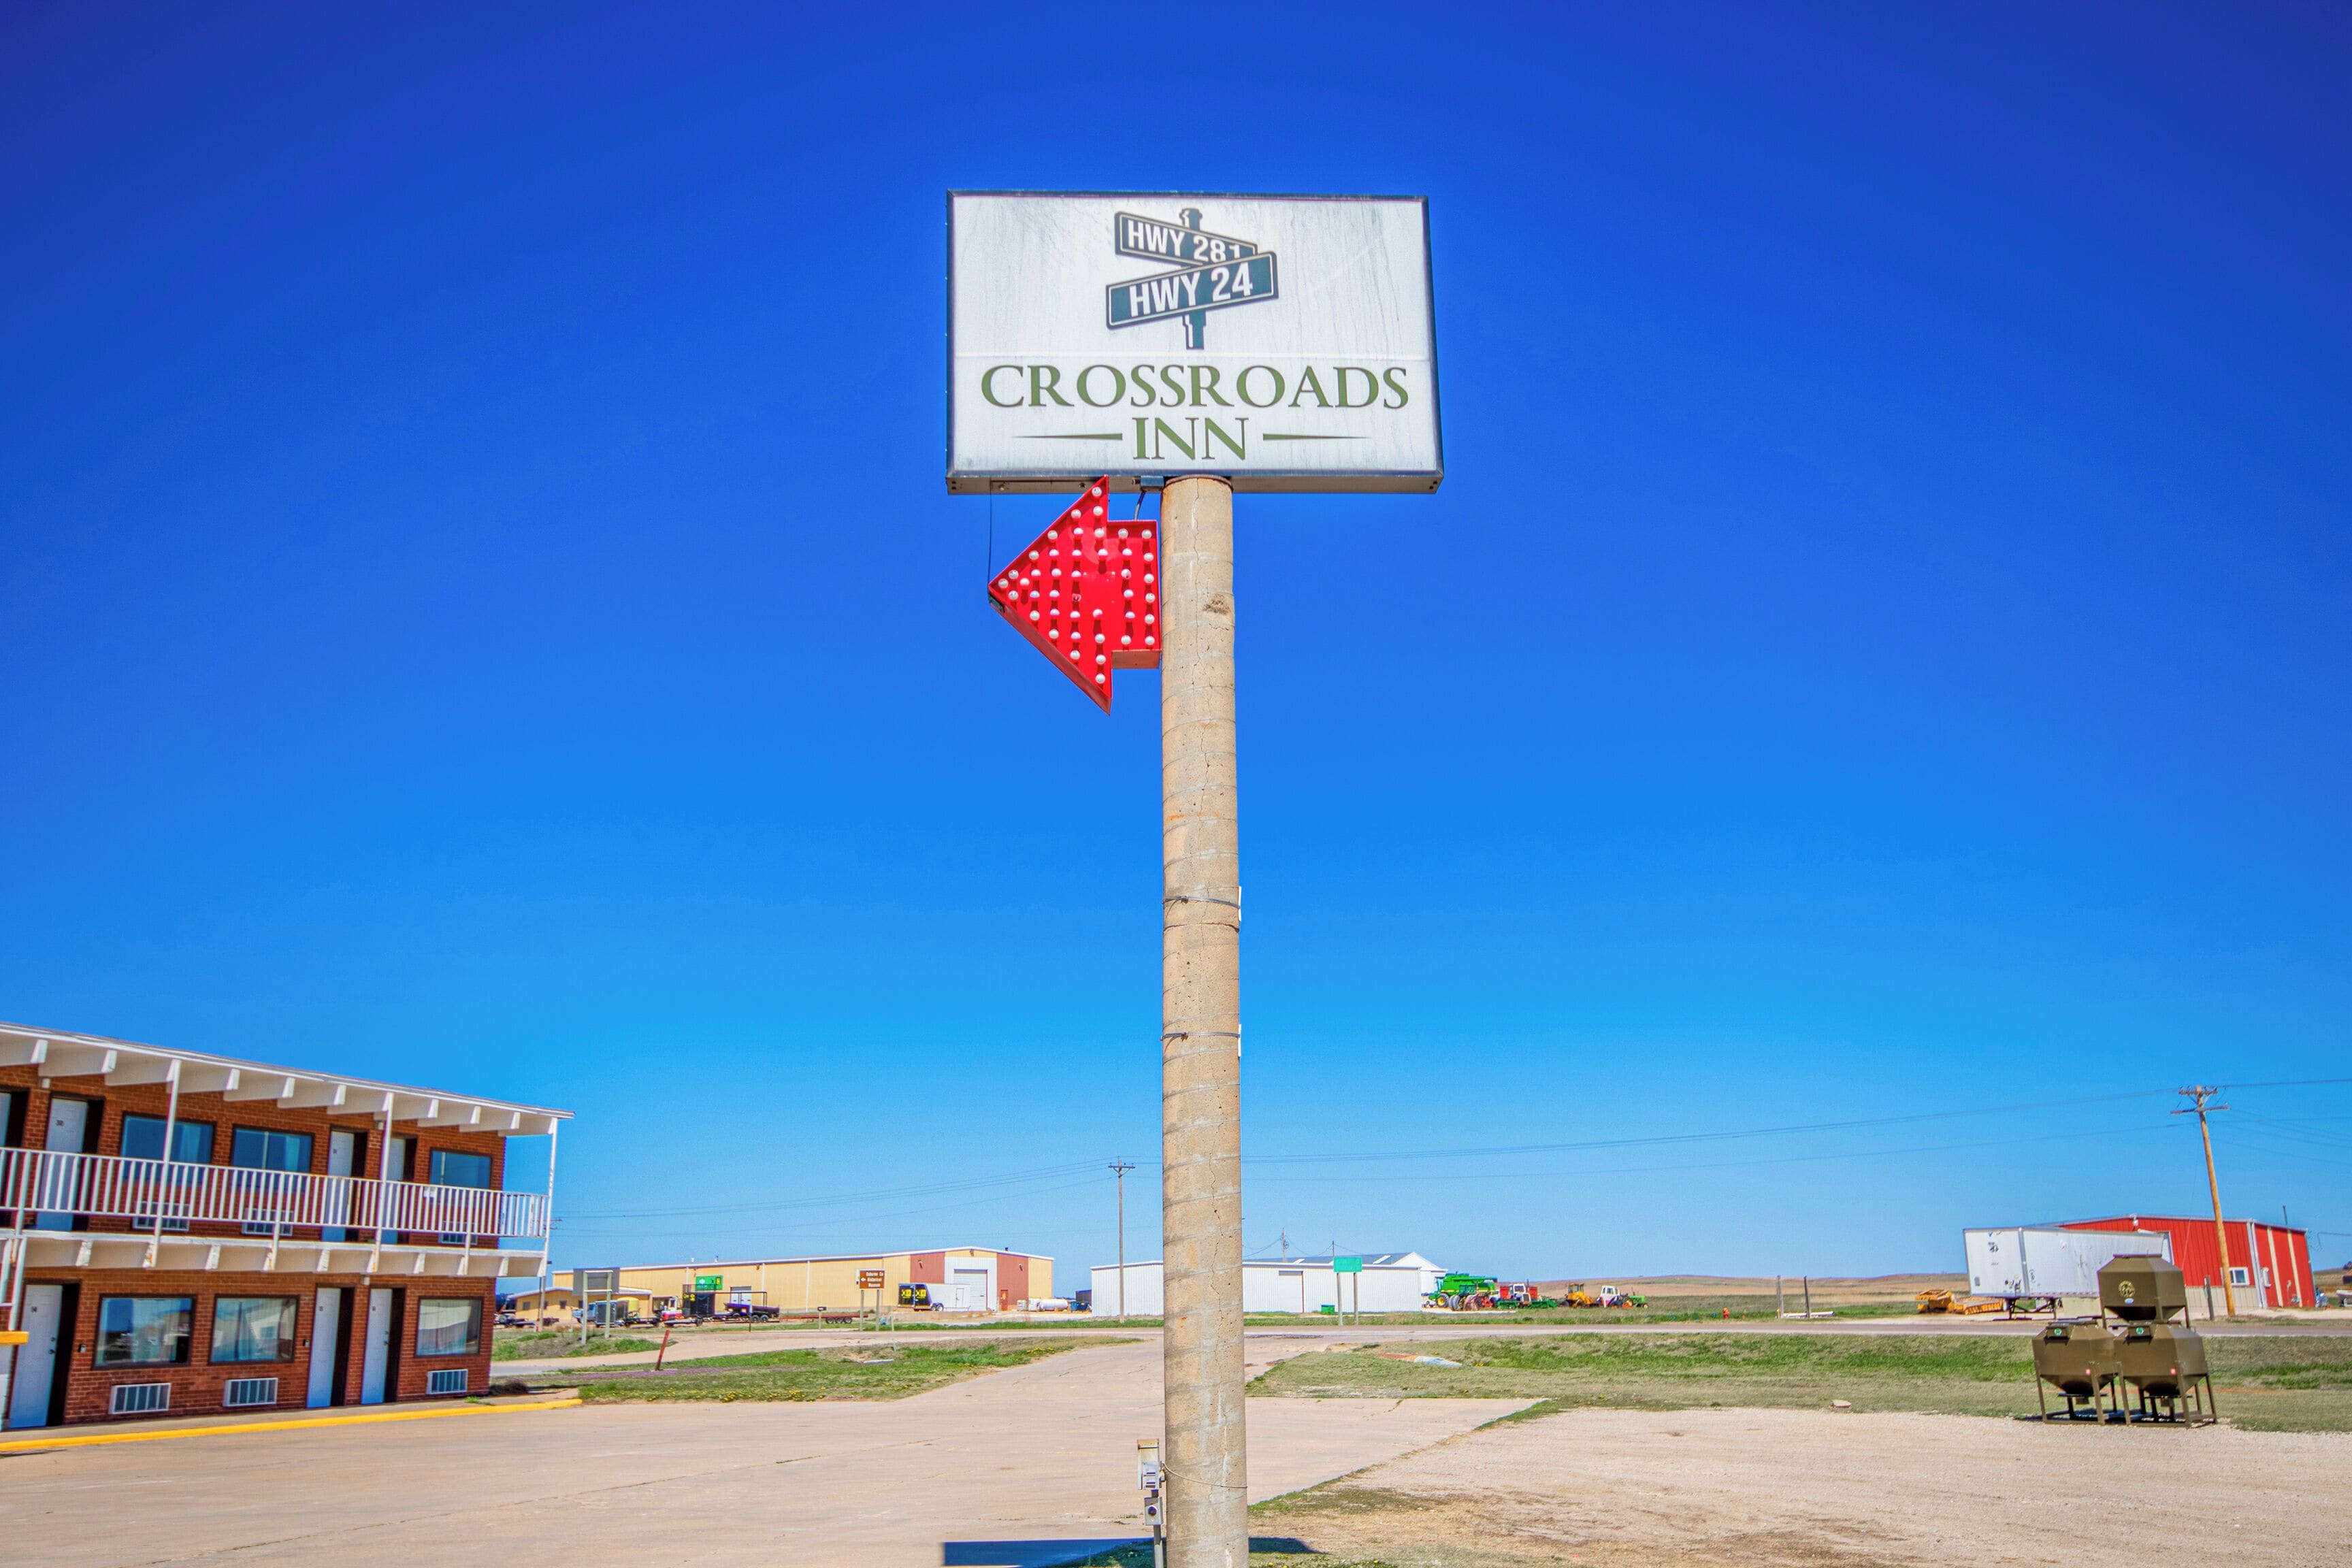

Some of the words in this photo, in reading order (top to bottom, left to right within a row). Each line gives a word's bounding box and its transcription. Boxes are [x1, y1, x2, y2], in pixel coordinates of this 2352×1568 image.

[1128, 219, 1186, 257] HWY
[1193, 235, 1241, 263] 281
[1129, 271, 1201, 318] HWY
[1211, 261, 1254, 303] 24
[981, 364, 1409, 409] CROSSROADS
[1132, 416, 1249, 461] INN
